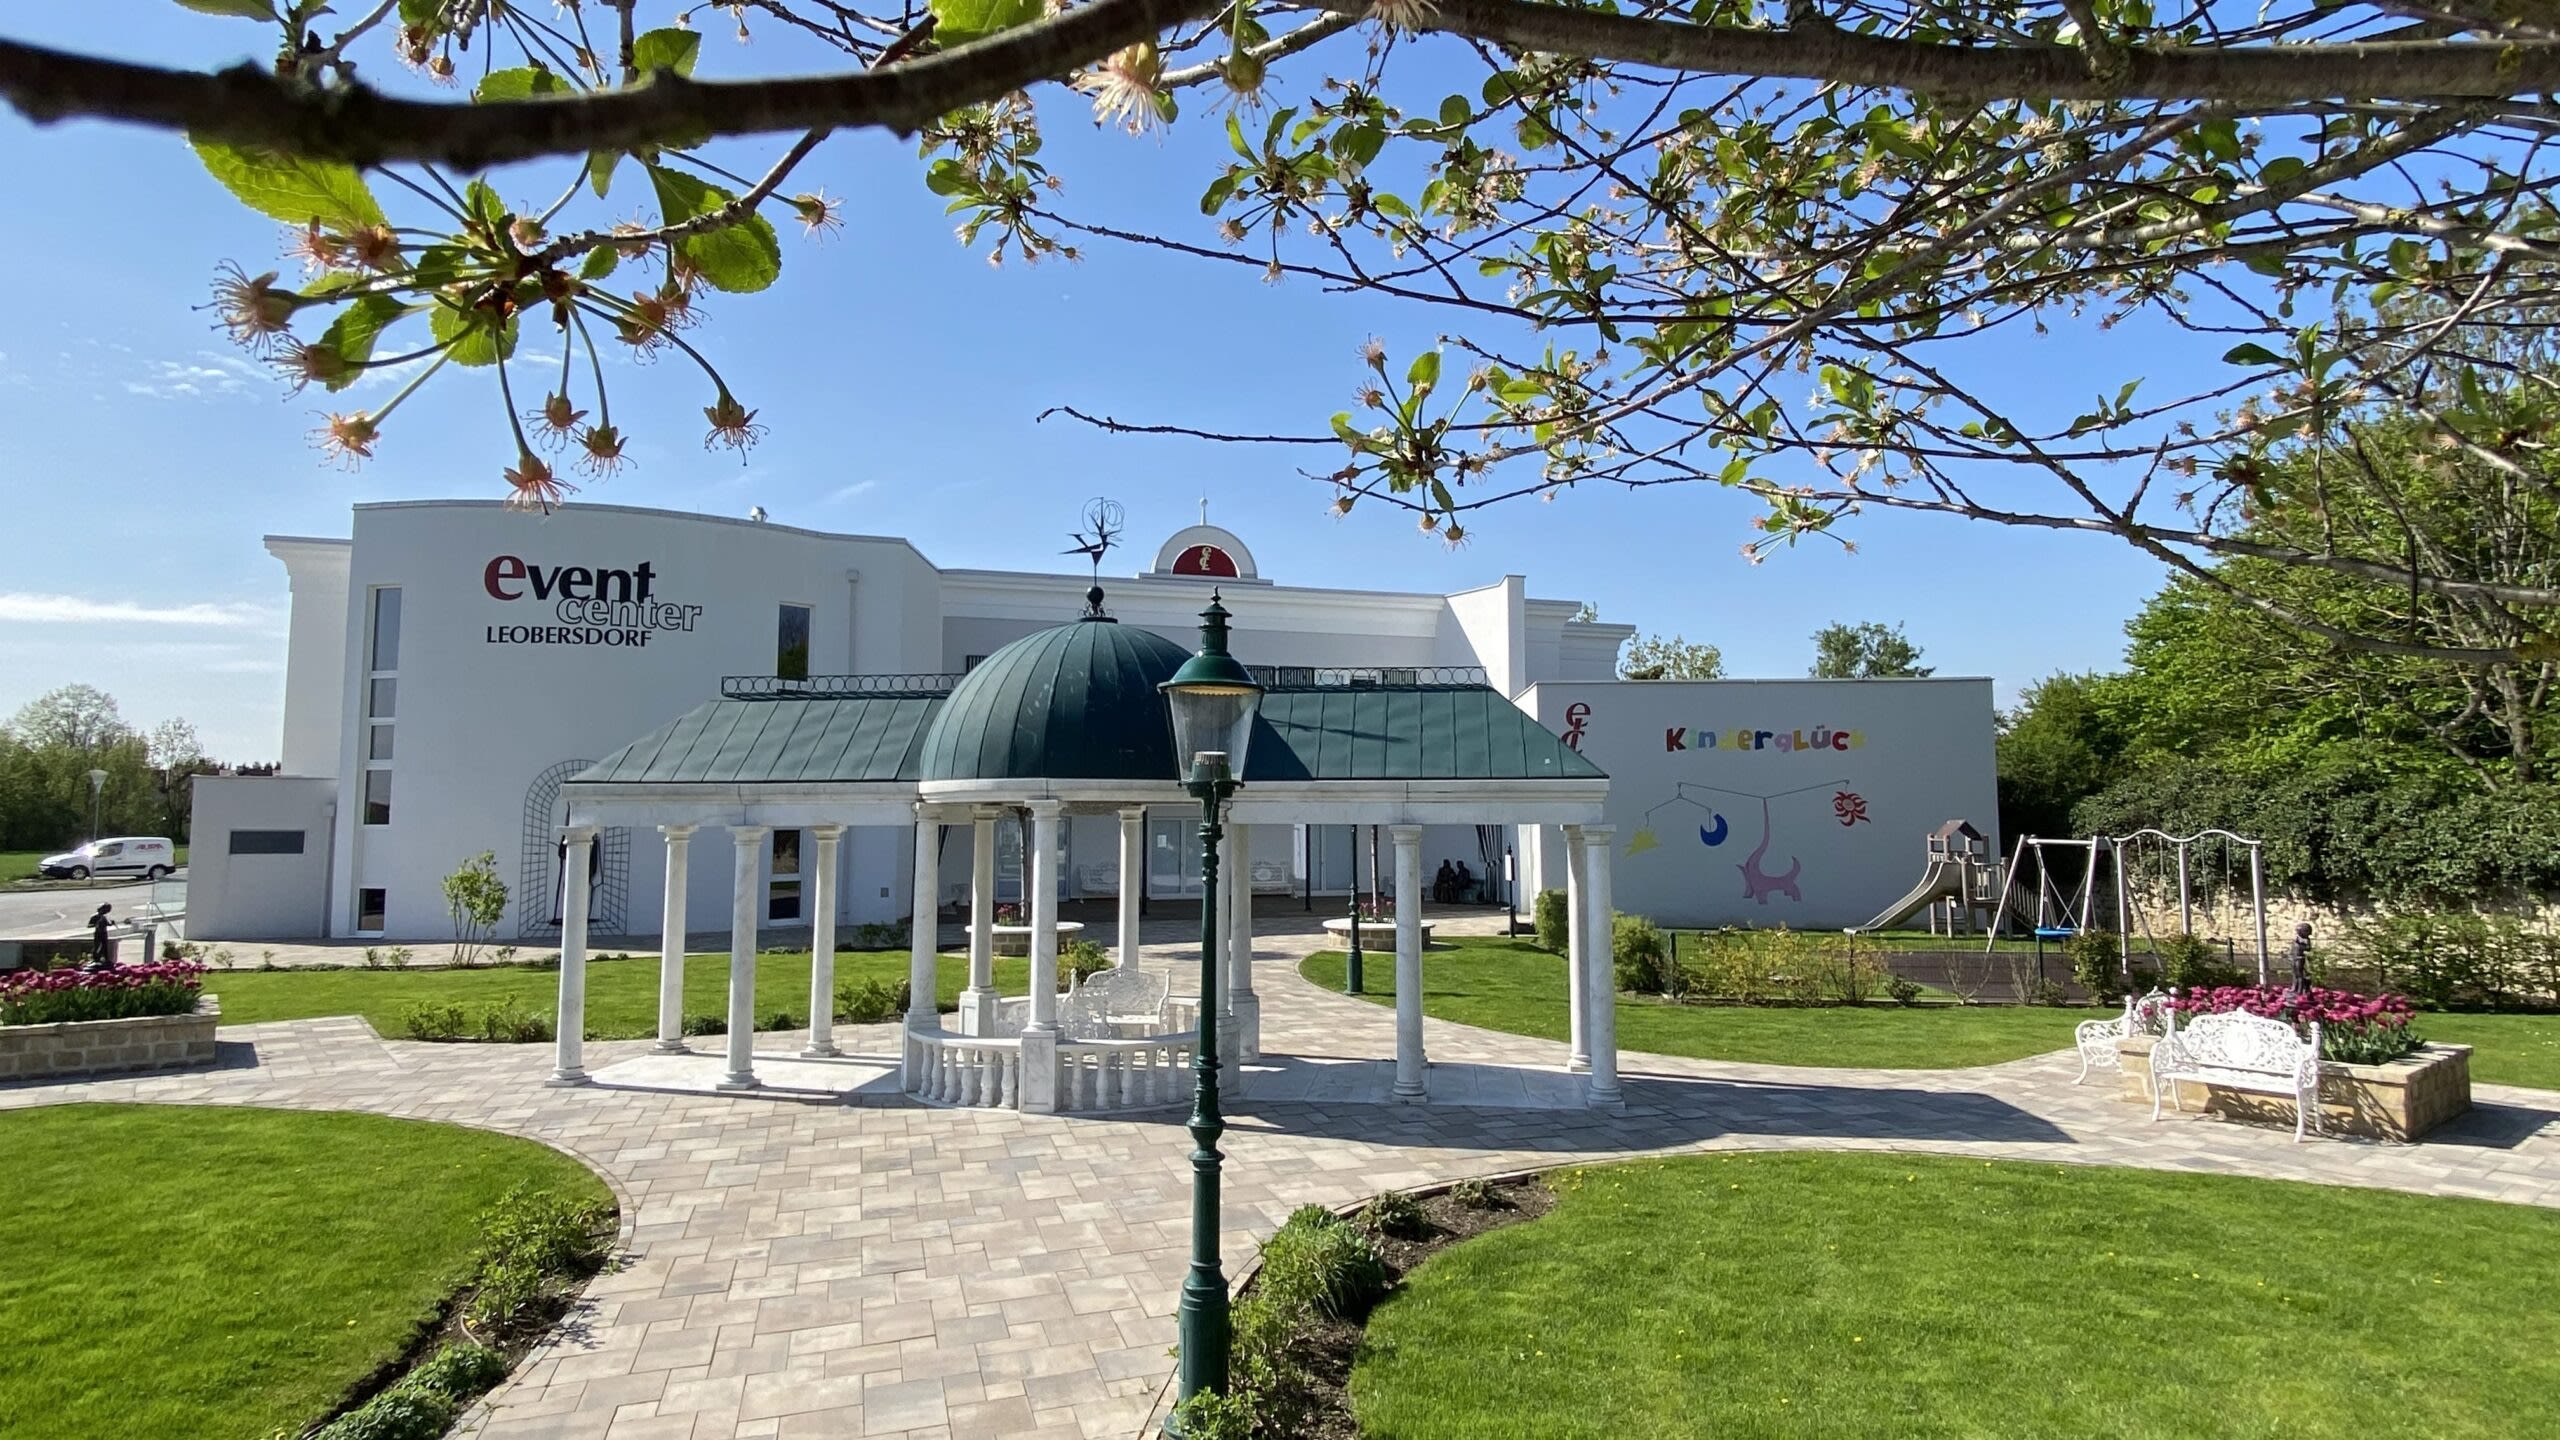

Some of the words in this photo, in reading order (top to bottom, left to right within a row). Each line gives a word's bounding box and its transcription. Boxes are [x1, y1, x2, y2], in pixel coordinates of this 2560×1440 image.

[484, 555, 656, 603] event
[556, 594, 702, 631] center
[486, 625, 652, 647] LEOBERSDORF
